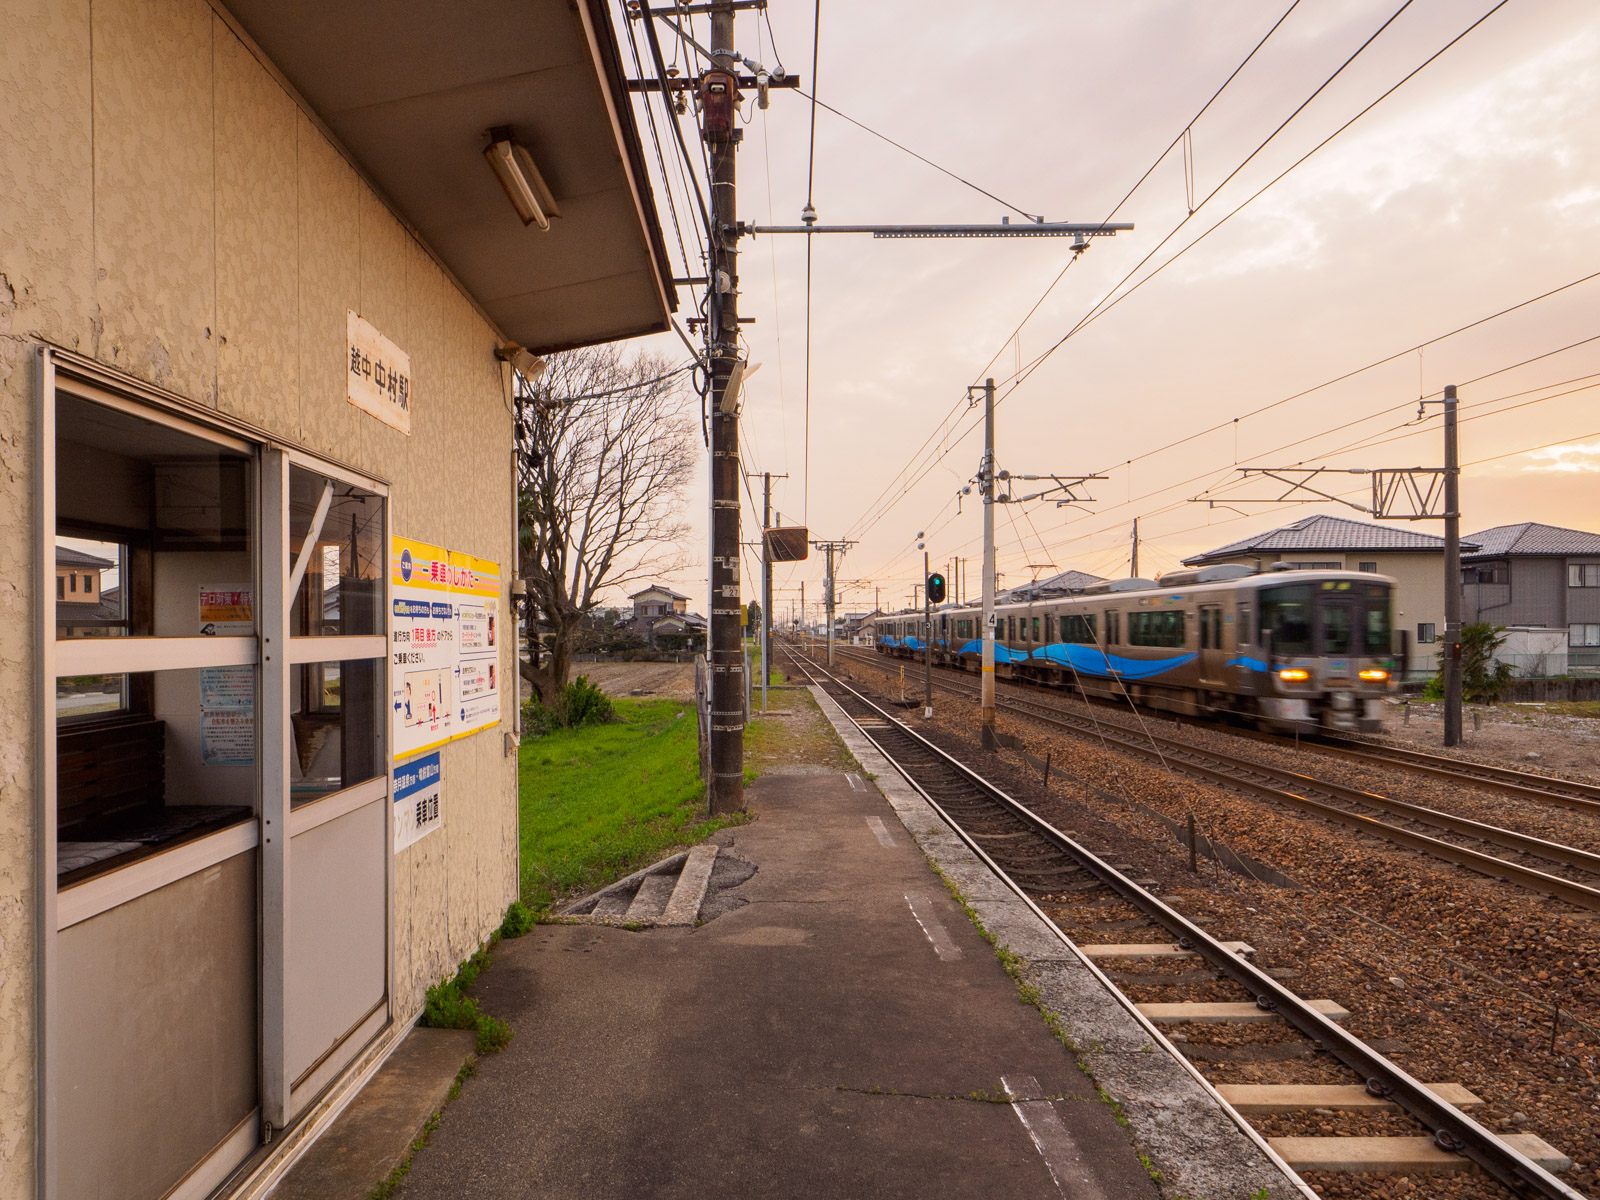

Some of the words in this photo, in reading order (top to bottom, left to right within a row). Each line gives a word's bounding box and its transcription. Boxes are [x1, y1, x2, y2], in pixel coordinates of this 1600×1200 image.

[350, 344, 409, 412] 越中中村駅
[989, 614, 995, 625] 4
